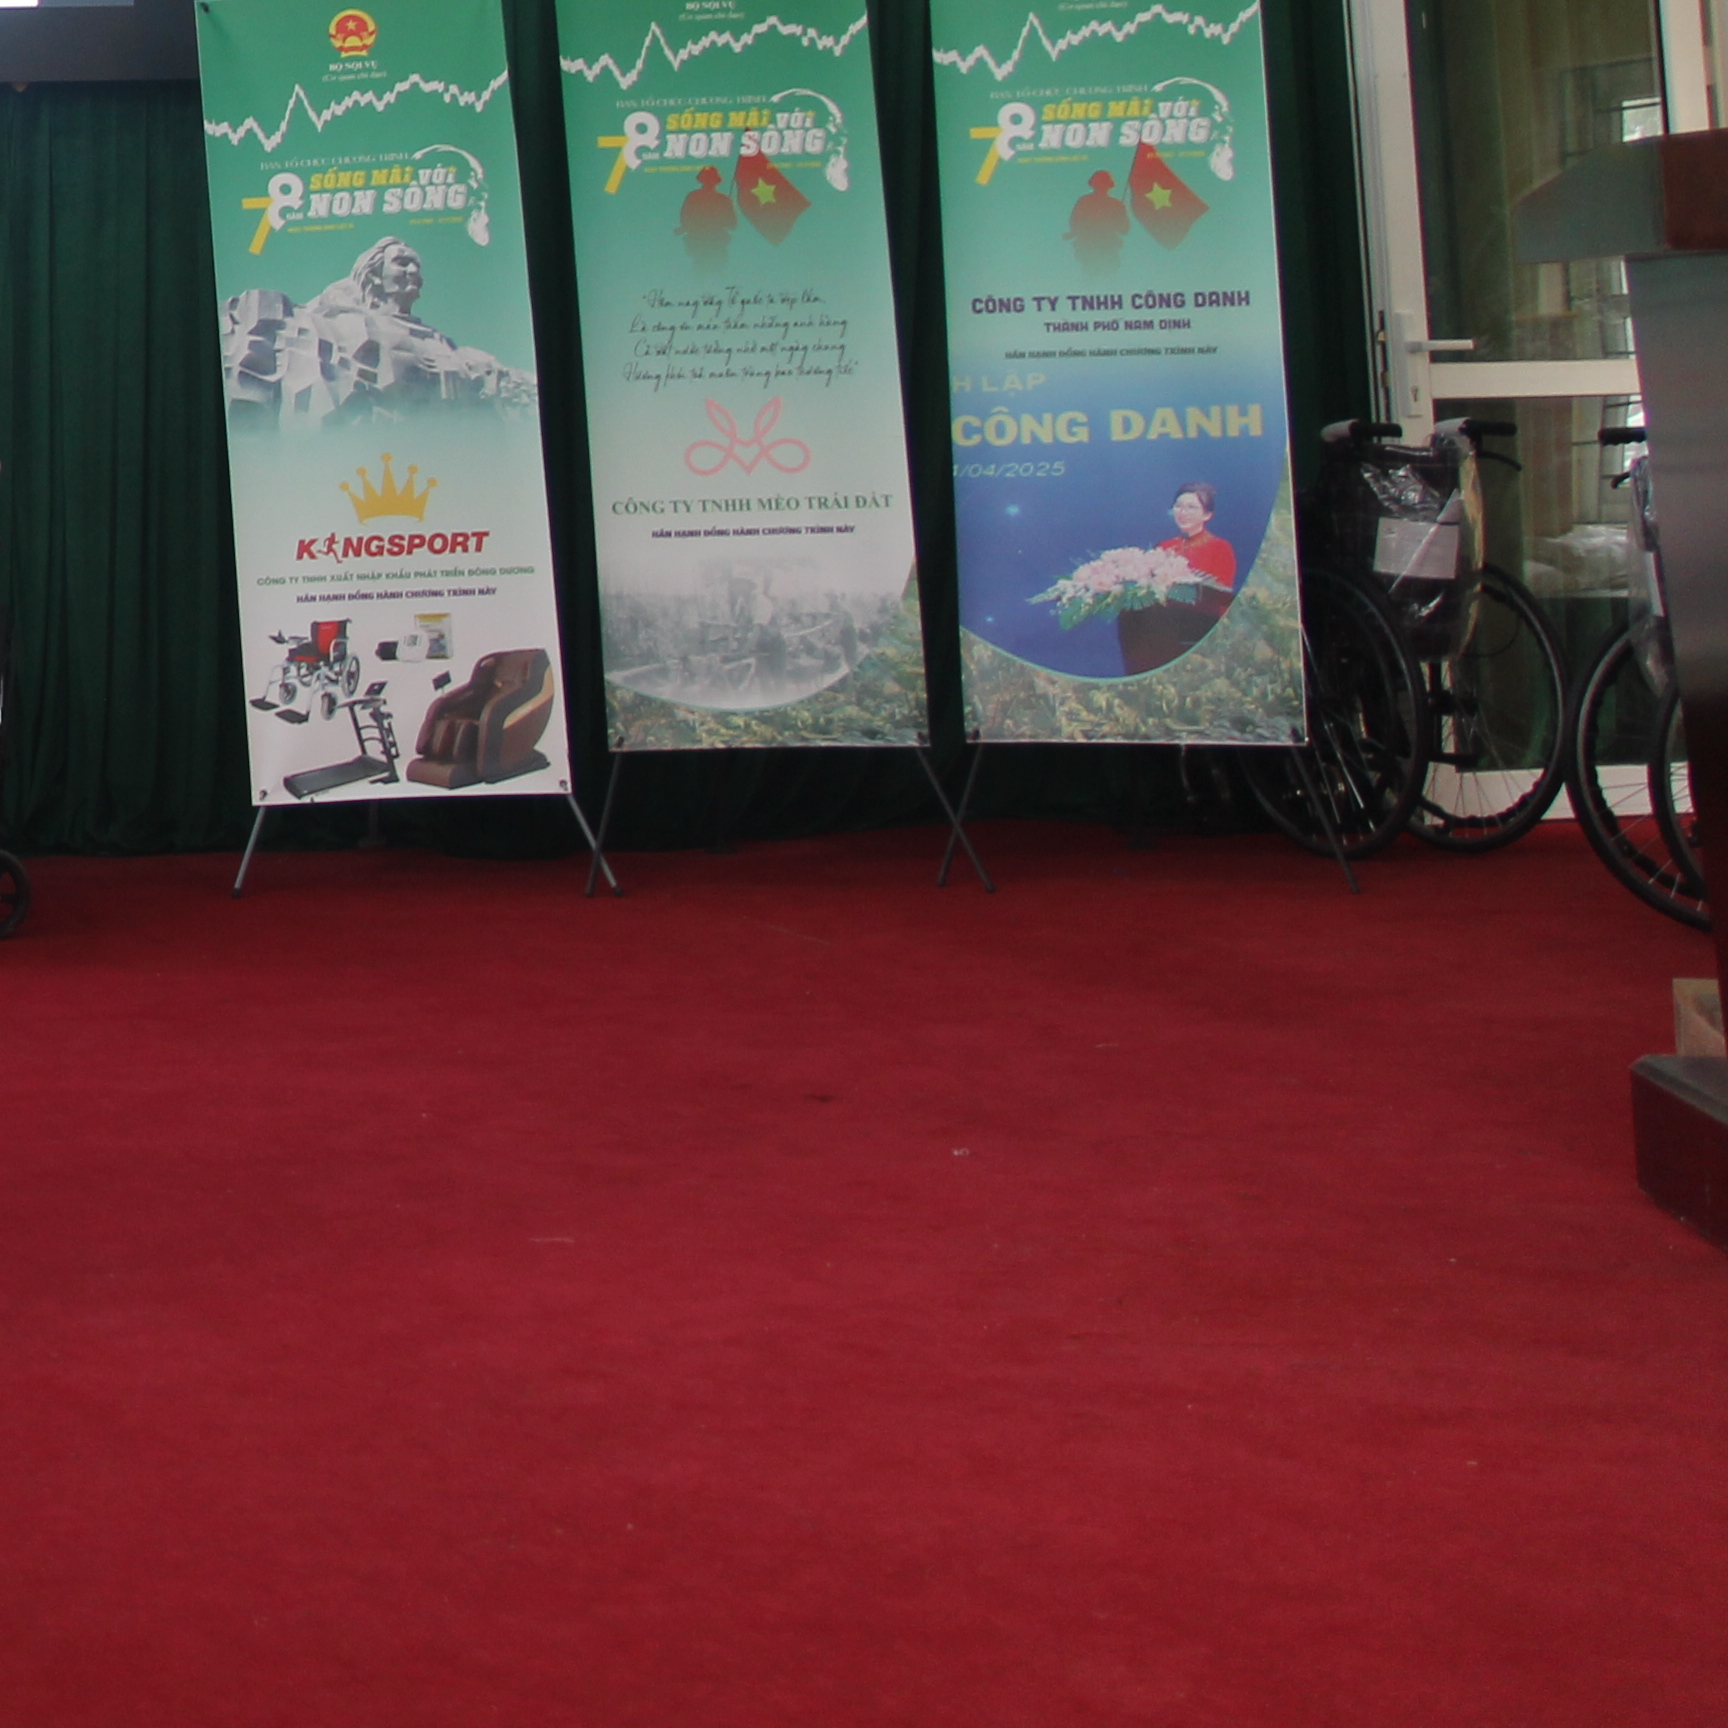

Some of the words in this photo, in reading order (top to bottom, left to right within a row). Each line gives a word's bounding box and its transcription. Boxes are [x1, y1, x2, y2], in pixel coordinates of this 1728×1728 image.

[666, 107, 724, 130] SỐNG
[728, 108, 772, 128] MÃI
[776, 108, 815, 128] VỚI
[1042, 97, 1103, 121] SỐNG
[1107, 97, 1153, 118] MÃI
[1158, 97, 1200, 119] VỚI
[664, 132, 735, 158] NON
[740, 124, 827, 157] SÔNG
[1039, 121, 1113, 149] NON
[1118, 113, 1213, 146] SÔNG
[309, 167, 366, 190] SỐNG
[370, 165, 413, 186] MÃI
[418, 163, 458, 185] VỚI
[307, 190, 377, 218] NON
[382, 181, 468, 214] SÔNG
[971, 295, 1024, 314] CÔNG
[1032, 297, 1059, 312] TY
[1067, 295, 1123, 311] TNHH
[1131, 290, 1185, 309] CÔNG
[1194, 291, 1250, 307] DANH
[1125, 319, 1154, 330] NAM
[981, 369, 1046, 396] LẬP
[952, 406, 1090, 446] CÔNG
[1110, 403, 1262, 441] DANH
[612, 497, 665, 515] CÔNG
[669, 500, 693, 514] TY
[699, 499, 752, 513] TNHH
[257, 576, 286, 586] CÔNG
[289, 576, 299, 584] TY
